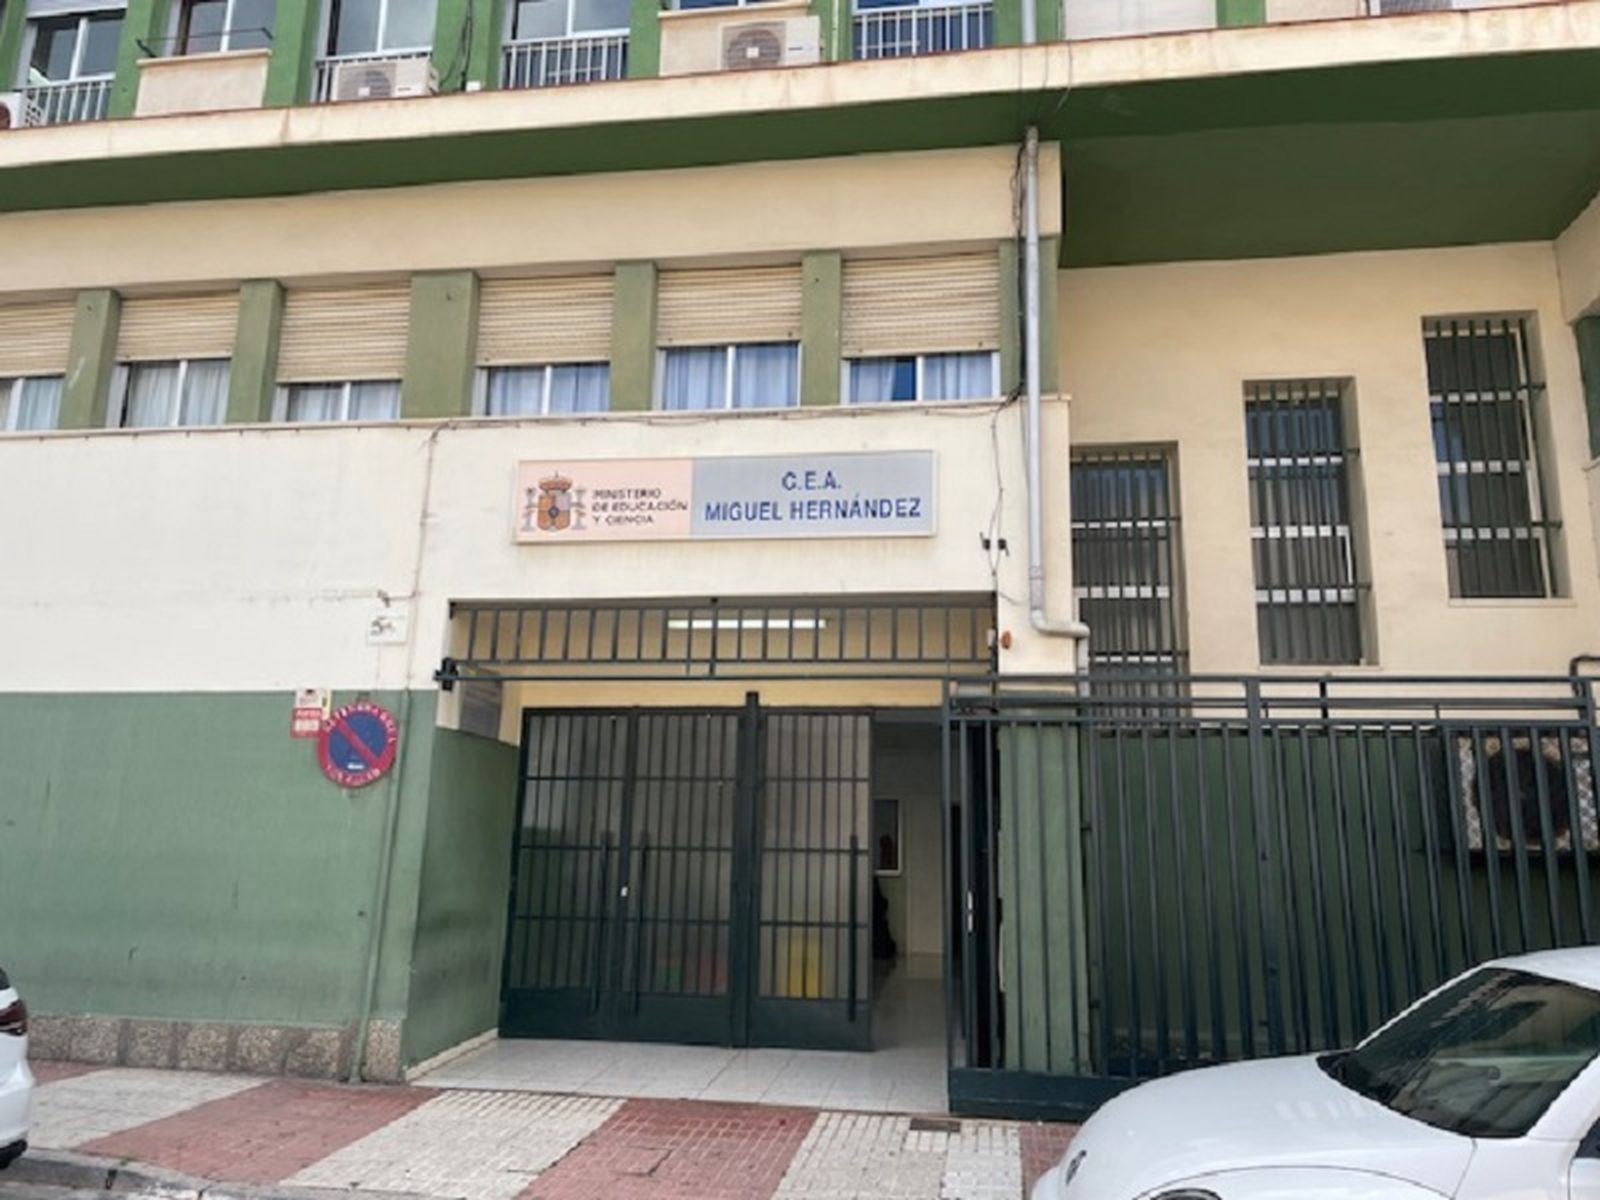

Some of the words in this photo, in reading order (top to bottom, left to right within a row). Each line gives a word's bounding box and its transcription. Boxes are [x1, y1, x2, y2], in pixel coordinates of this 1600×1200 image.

[781, 469, 842, 491] C.E.A.
[592, 487, 662, 500] MINISTERIO
[592, 502, 609, 513] DE
[612, 499, 688, 512] EDUCACIÓN
[704, 501, 783, 522] MIGUEL
[789, 495, 922, 520] HERNÁNDEZ
[592, 515, 602, 525] Y
[605, 514, 654, 525] CIENCIA
